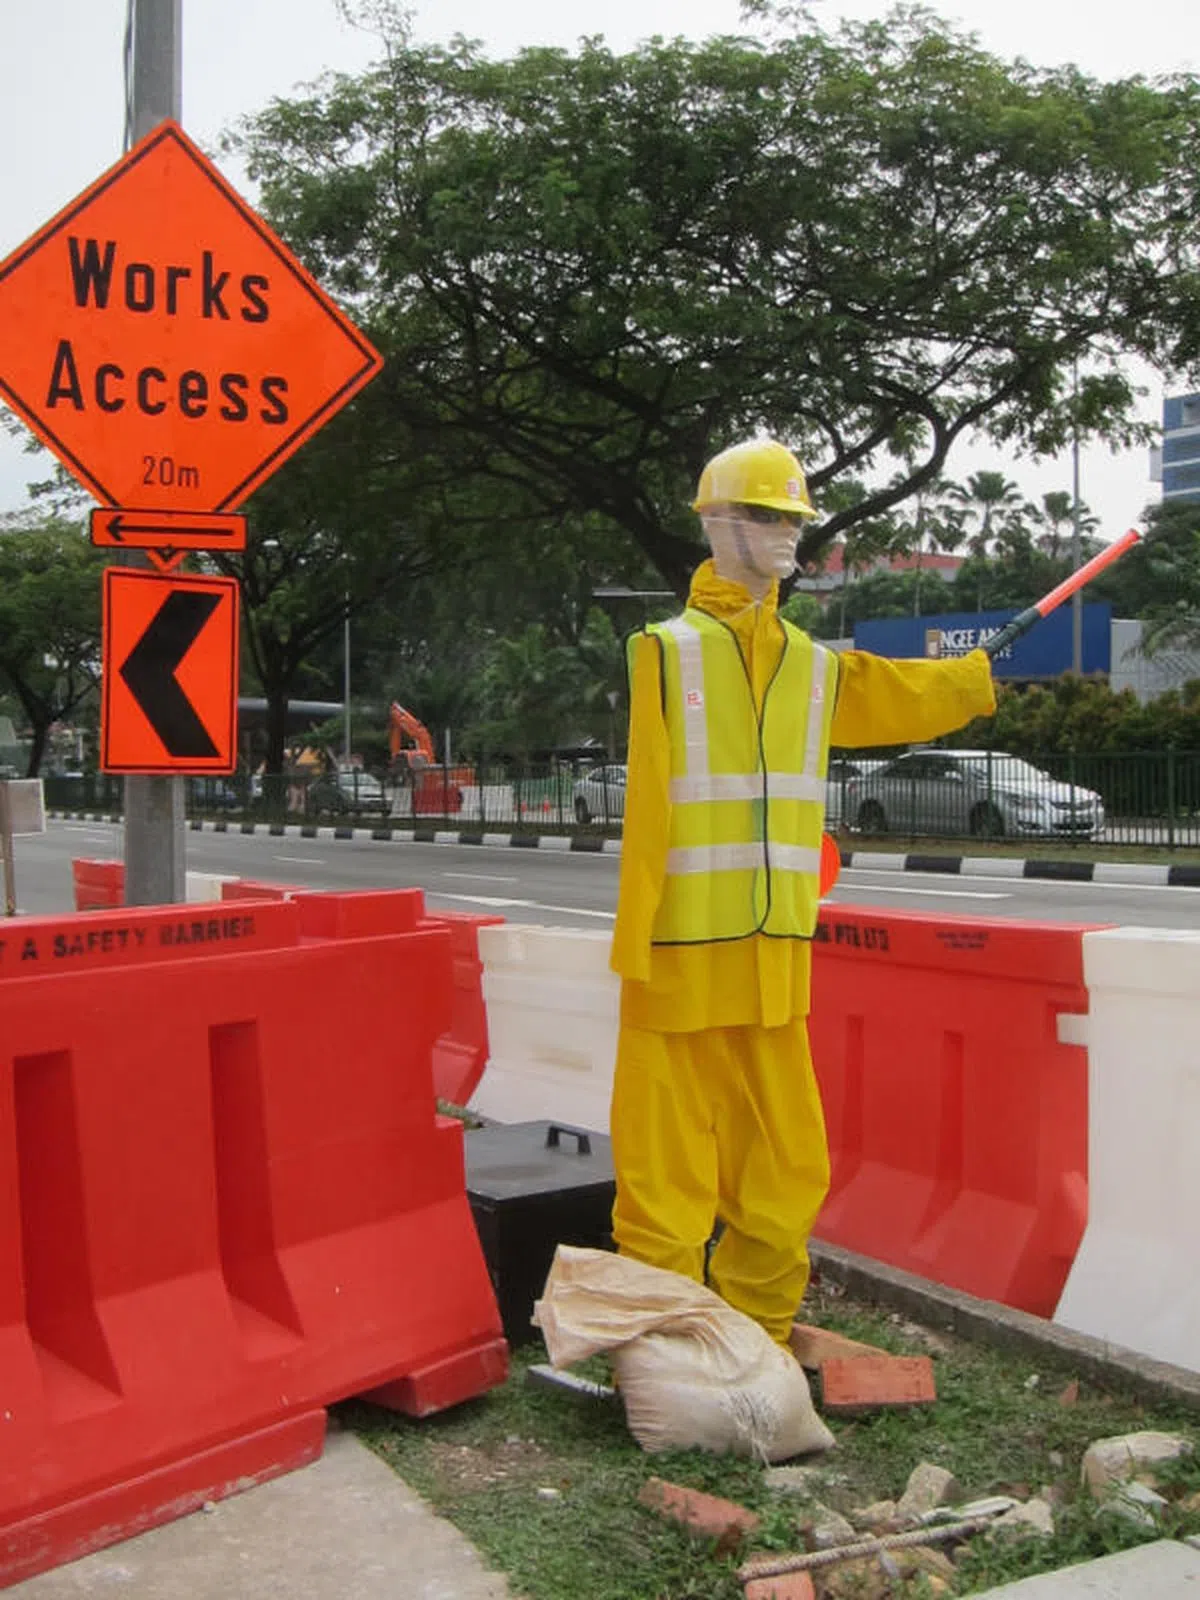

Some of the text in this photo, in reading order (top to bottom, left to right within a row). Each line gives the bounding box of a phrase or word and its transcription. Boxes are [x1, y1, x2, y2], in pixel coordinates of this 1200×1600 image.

[68, 236, 270, 323] Works
[46, 339, 289, 426] Access
[142, 455, 200, 489] 20m
[940, 628, 976, 649] NGEE
[21, 937, 39, 961] A
[53, 928, 148, 958] SAFETY
[159, 916, 256, 946] BARRIER
